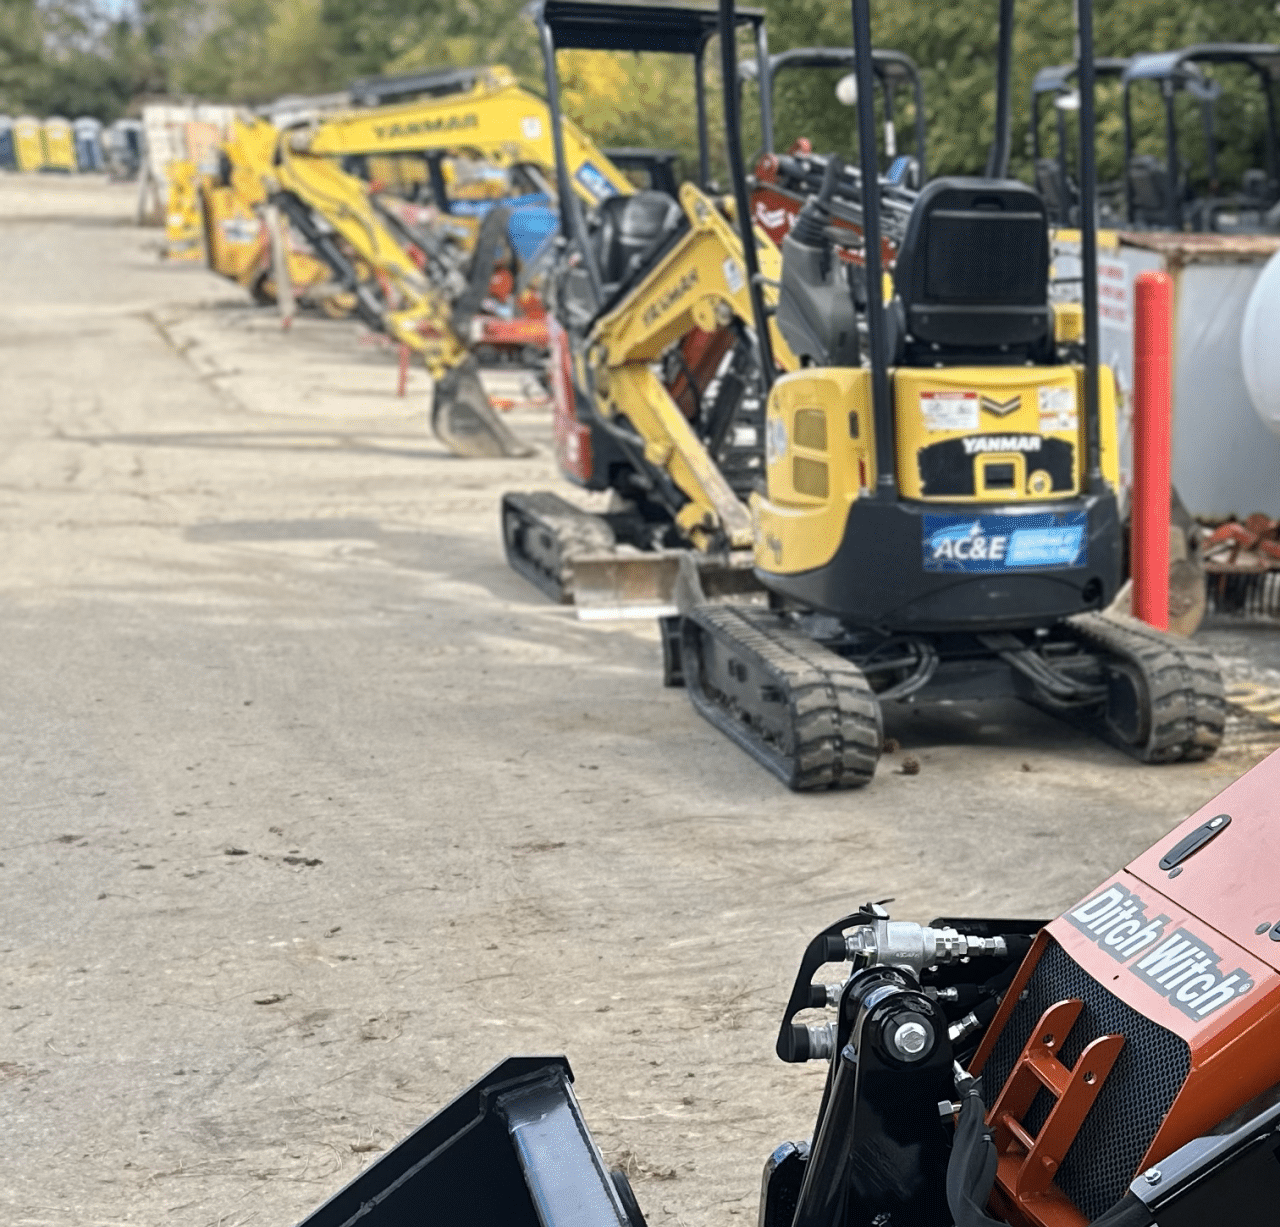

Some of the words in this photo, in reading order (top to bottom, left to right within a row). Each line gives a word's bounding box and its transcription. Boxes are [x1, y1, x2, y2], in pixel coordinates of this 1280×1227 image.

[962, 436, 1042, 454] YANMAR
[933, 536, 1007, 560] AC&E
[1070, 887, 1164, 958] Ditch
[1136, 932, 1242, 1017] Witch
